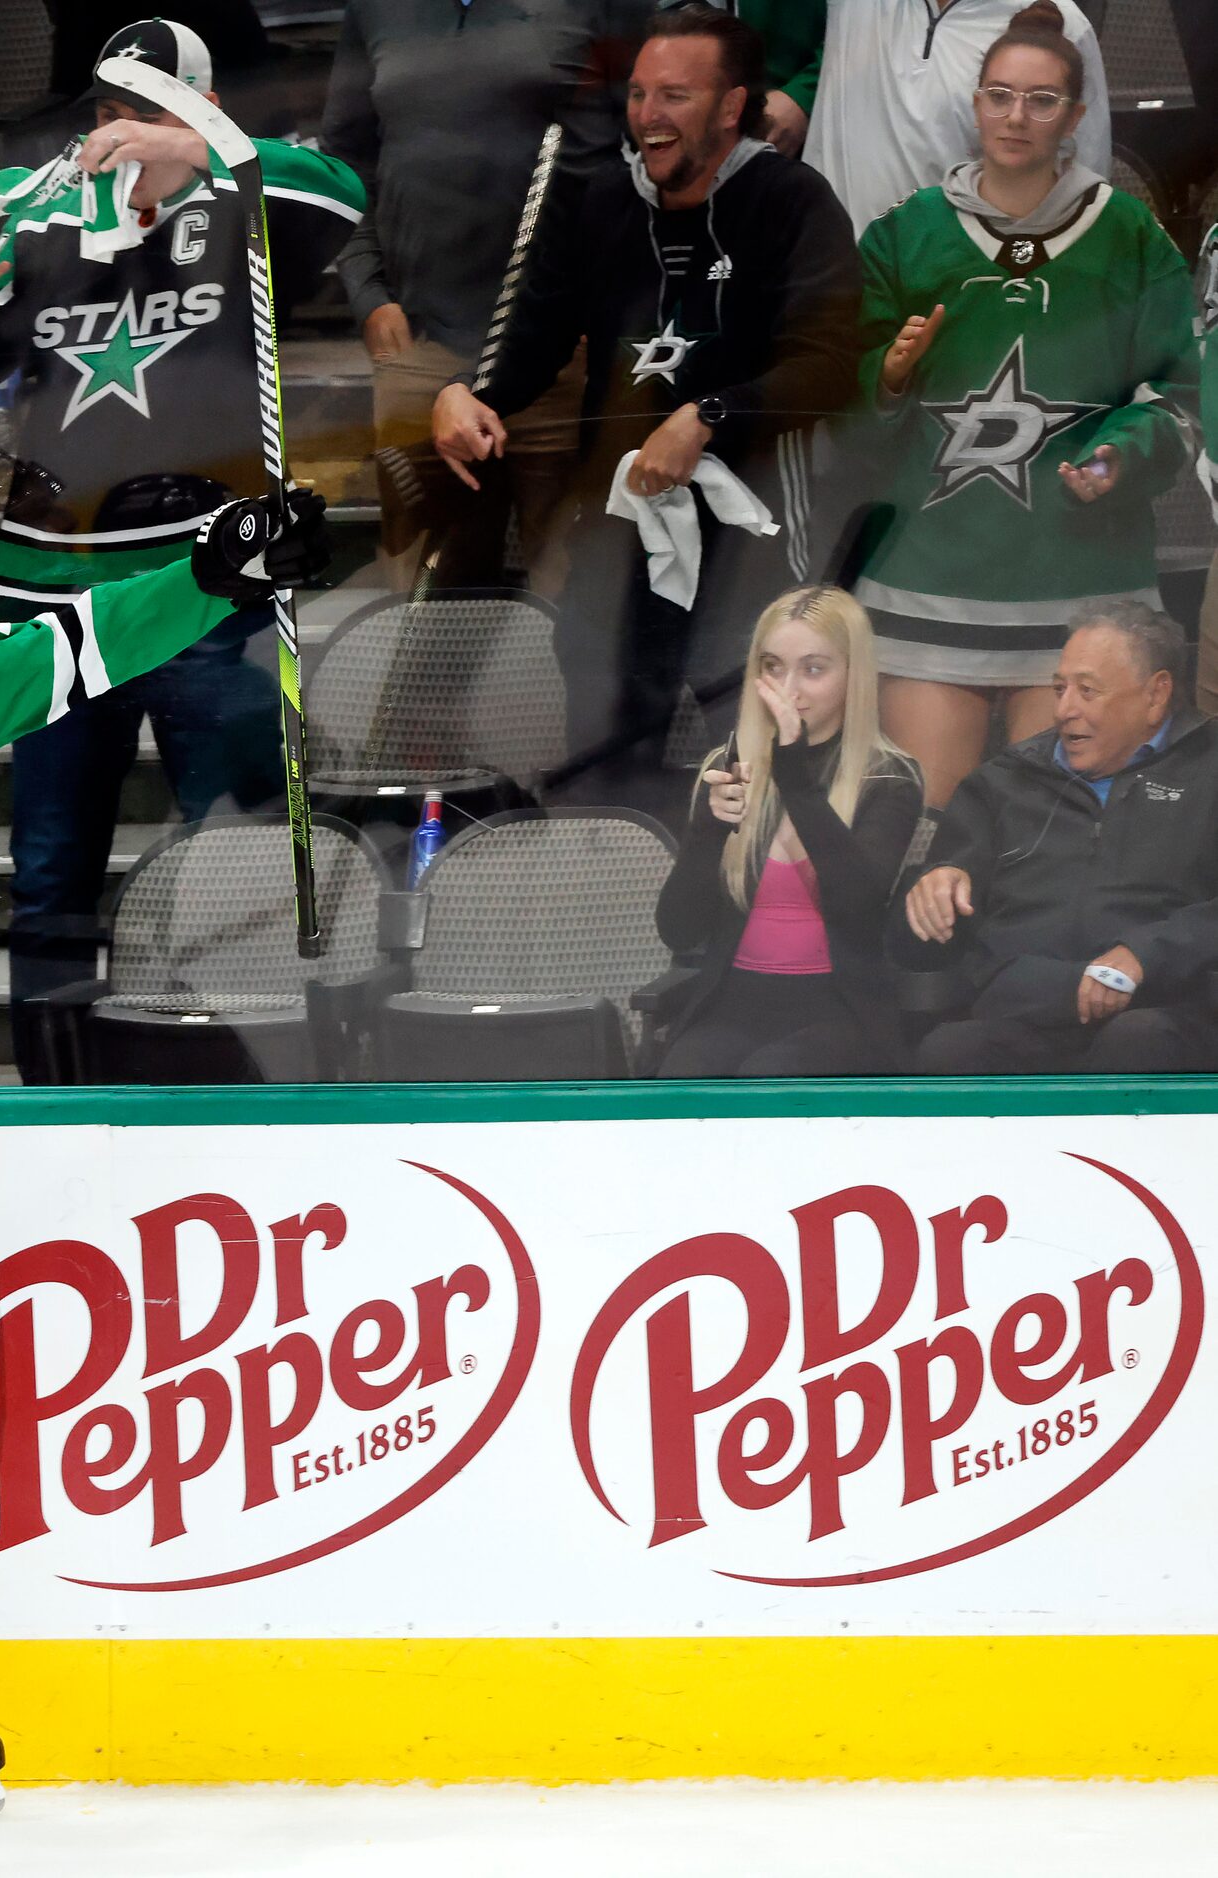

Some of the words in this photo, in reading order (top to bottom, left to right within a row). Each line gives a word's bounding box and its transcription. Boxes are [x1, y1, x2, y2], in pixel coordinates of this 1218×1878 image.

[32, 282, 226, 349] STARS
[170, 209, 209, 266] C
[247, 247, 283, 480] WARRIOR
[289, 782, 308, 849] ALPHA
[131, 1191, 347, 1380] Dr
[788, 1184, 1008, 1374] Dr
[570, 1232, 1154, 1549] Pepper
